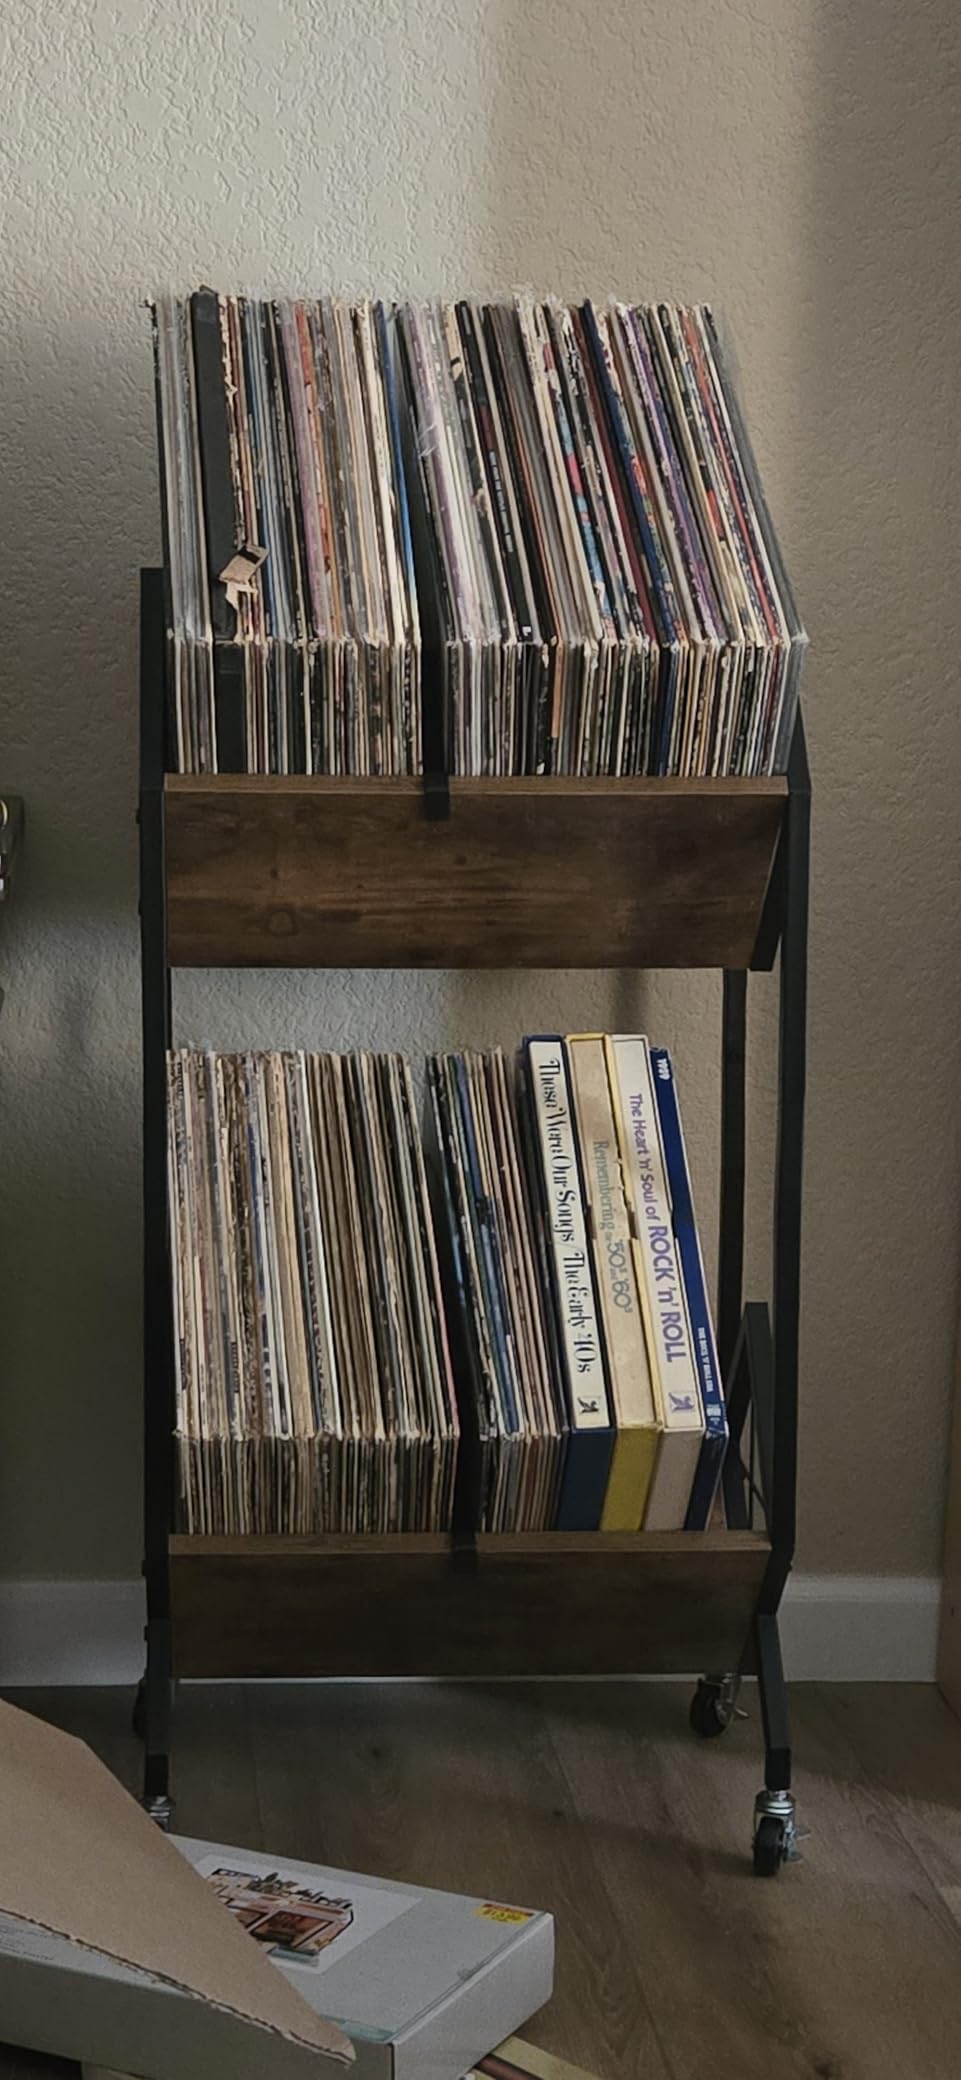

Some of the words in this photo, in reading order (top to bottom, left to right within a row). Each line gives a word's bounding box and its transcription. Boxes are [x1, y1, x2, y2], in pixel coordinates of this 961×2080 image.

[538, 1057, 561, 1109] These
[629, 1094, 643, 1117] The
[545, 1108, 568, 1154] Were
[632, 1120, 648, 1155] Heart
[551, 1155, 573, 1188] Our
[593, 1140, 617, 1231] Remembering
[641, 1174, 657, 1203] Soul
[553, 1190, 576, 1242] Songs
[645, 1205, 660, 1222] of
[563, 1252, 585, 1284] The
[649, 1225, 675, 1282] ROCK
[568, 1286, 592, 1330] Early
[657, 1286, 678, 1307] 'n'
[660, 1311, 687, 1363] ROLL
